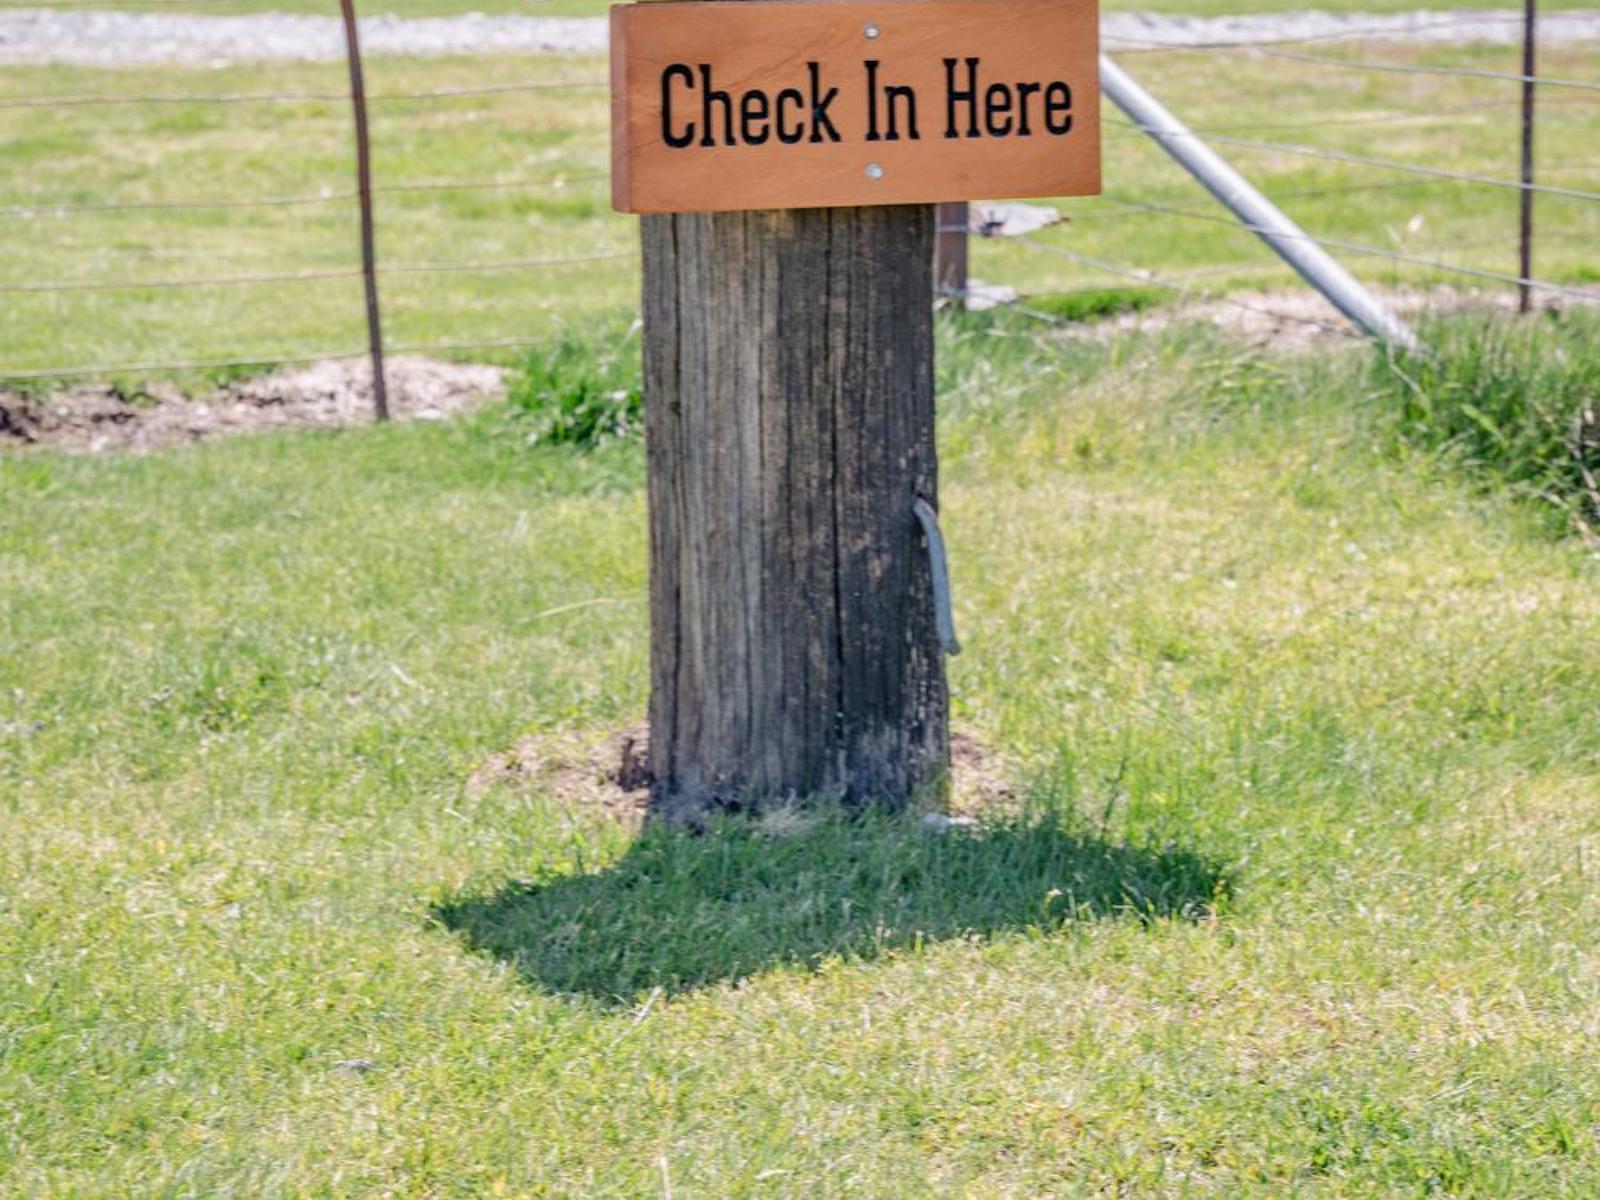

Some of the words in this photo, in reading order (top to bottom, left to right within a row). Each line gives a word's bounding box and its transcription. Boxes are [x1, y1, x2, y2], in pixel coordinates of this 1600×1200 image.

[660, 61, 842, 149] Check
[863, 59, 921, 142] In
[942, 56, 1073, 139] Here
